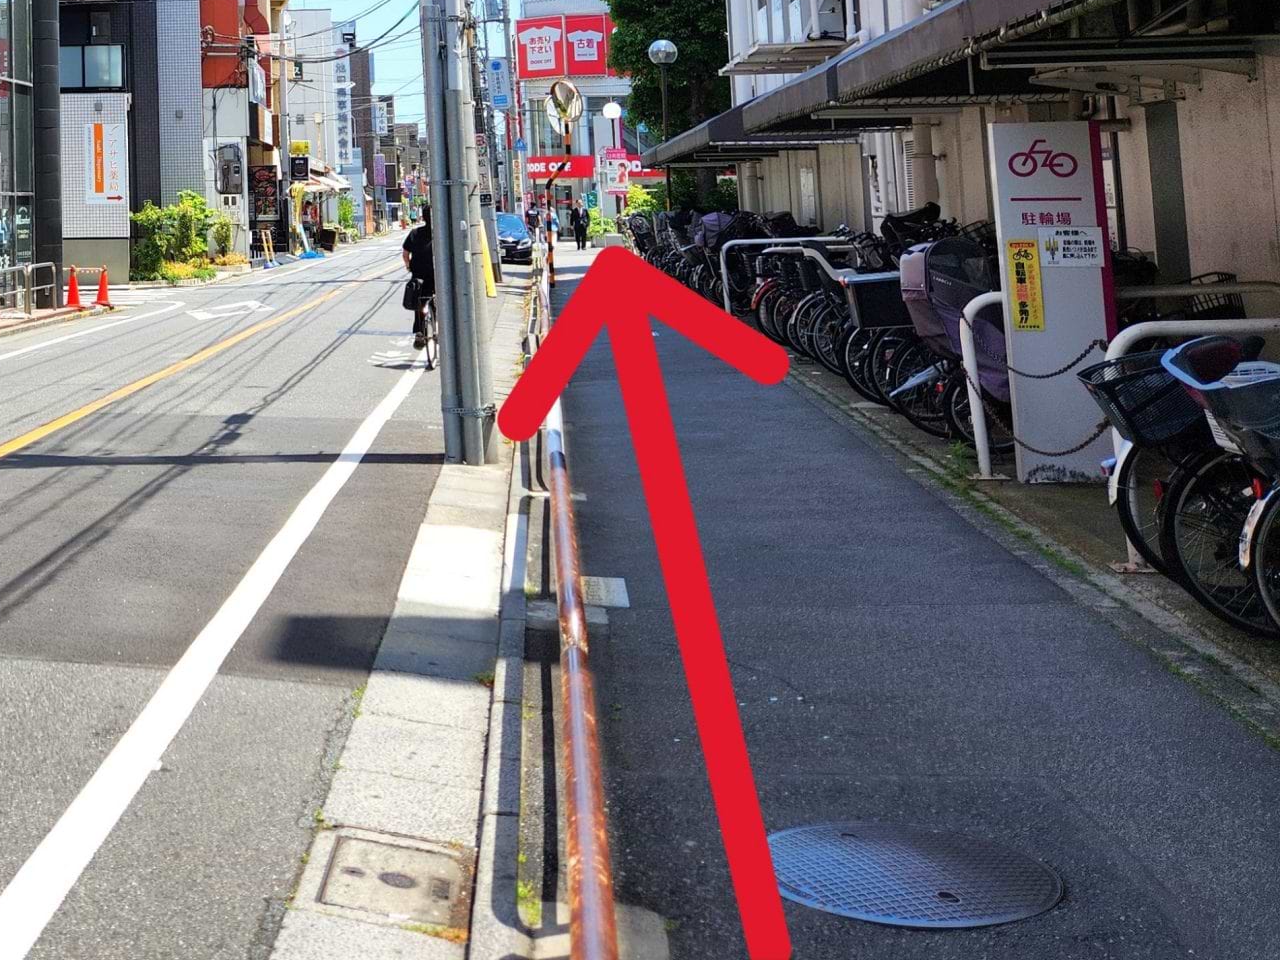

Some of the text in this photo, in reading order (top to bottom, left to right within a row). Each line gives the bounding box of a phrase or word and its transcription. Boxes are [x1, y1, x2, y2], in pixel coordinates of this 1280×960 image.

[529, 35, 551, 45] お売り
[577, 38, 594, 49] 古着
[529, 46, 552, 54] 下さい
[1021, 212, 1072, 226] 駐輪場
